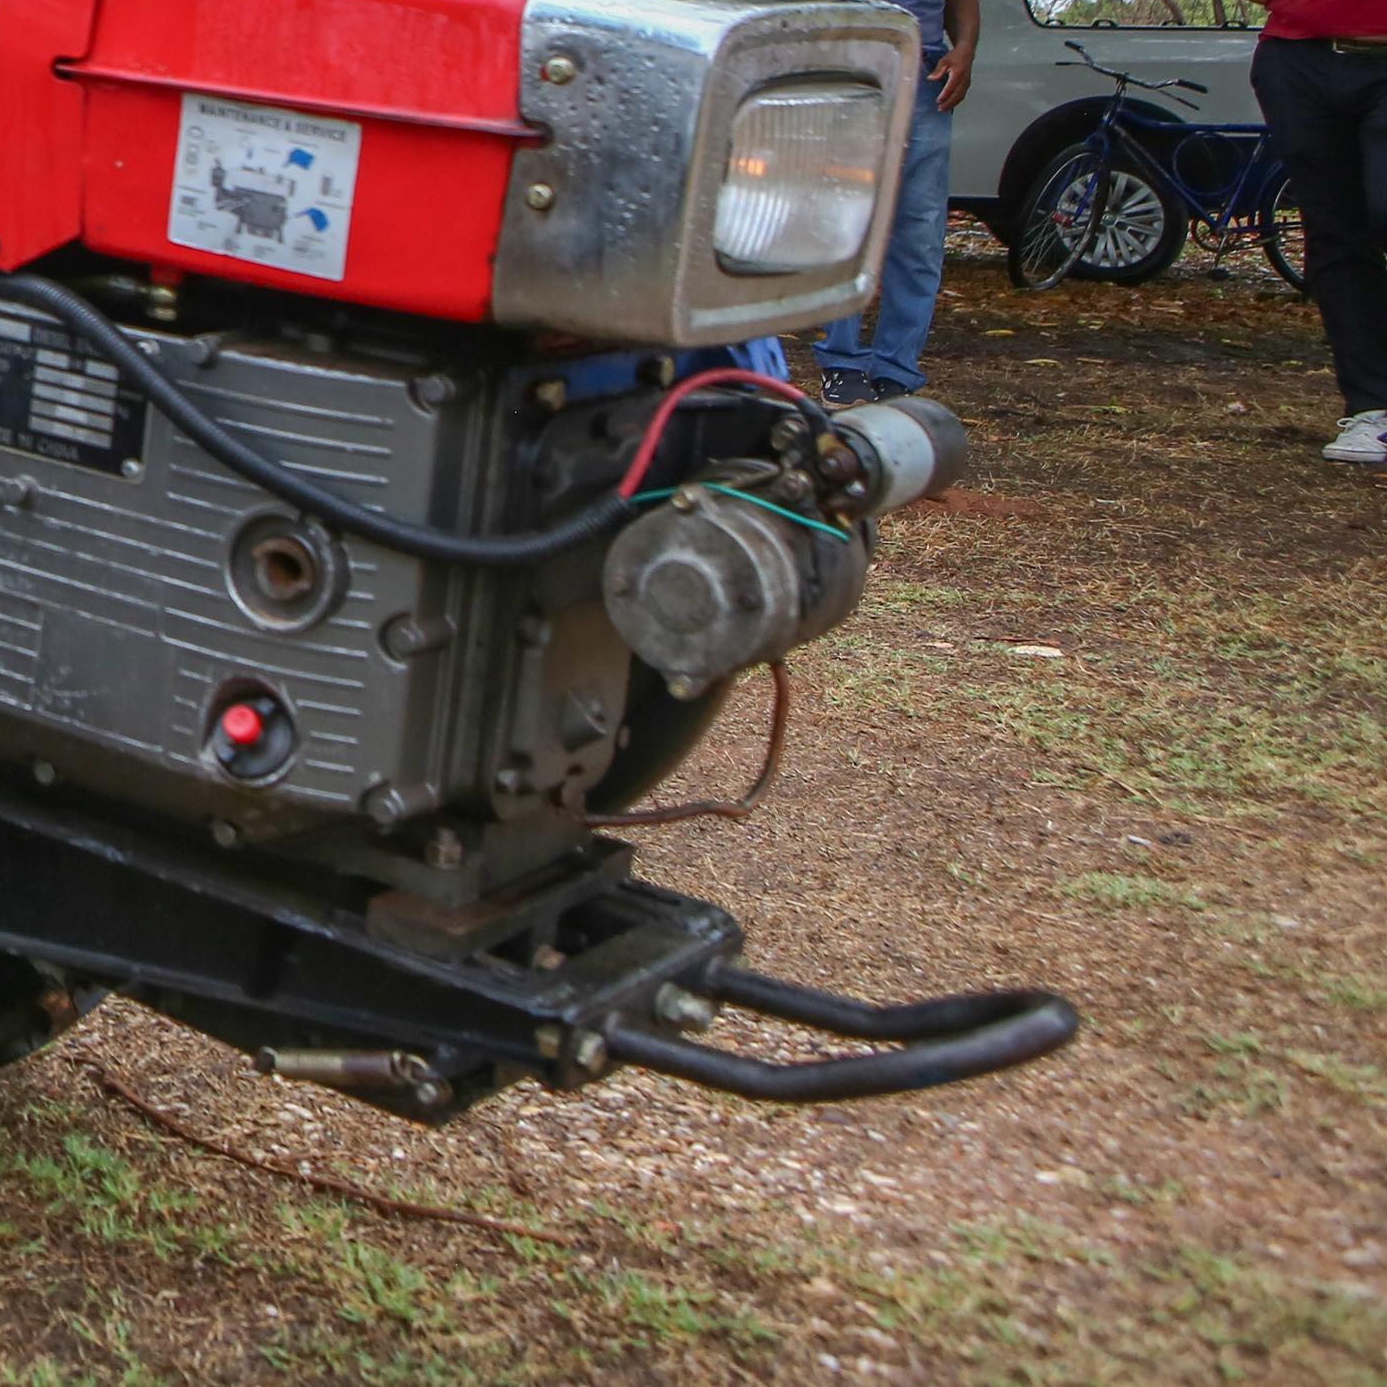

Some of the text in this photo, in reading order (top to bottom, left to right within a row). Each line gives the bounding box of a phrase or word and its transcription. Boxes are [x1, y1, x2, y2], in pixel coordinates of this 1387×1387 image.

[199, 101, 346, 143] MAINTENANCE & SERVICE
